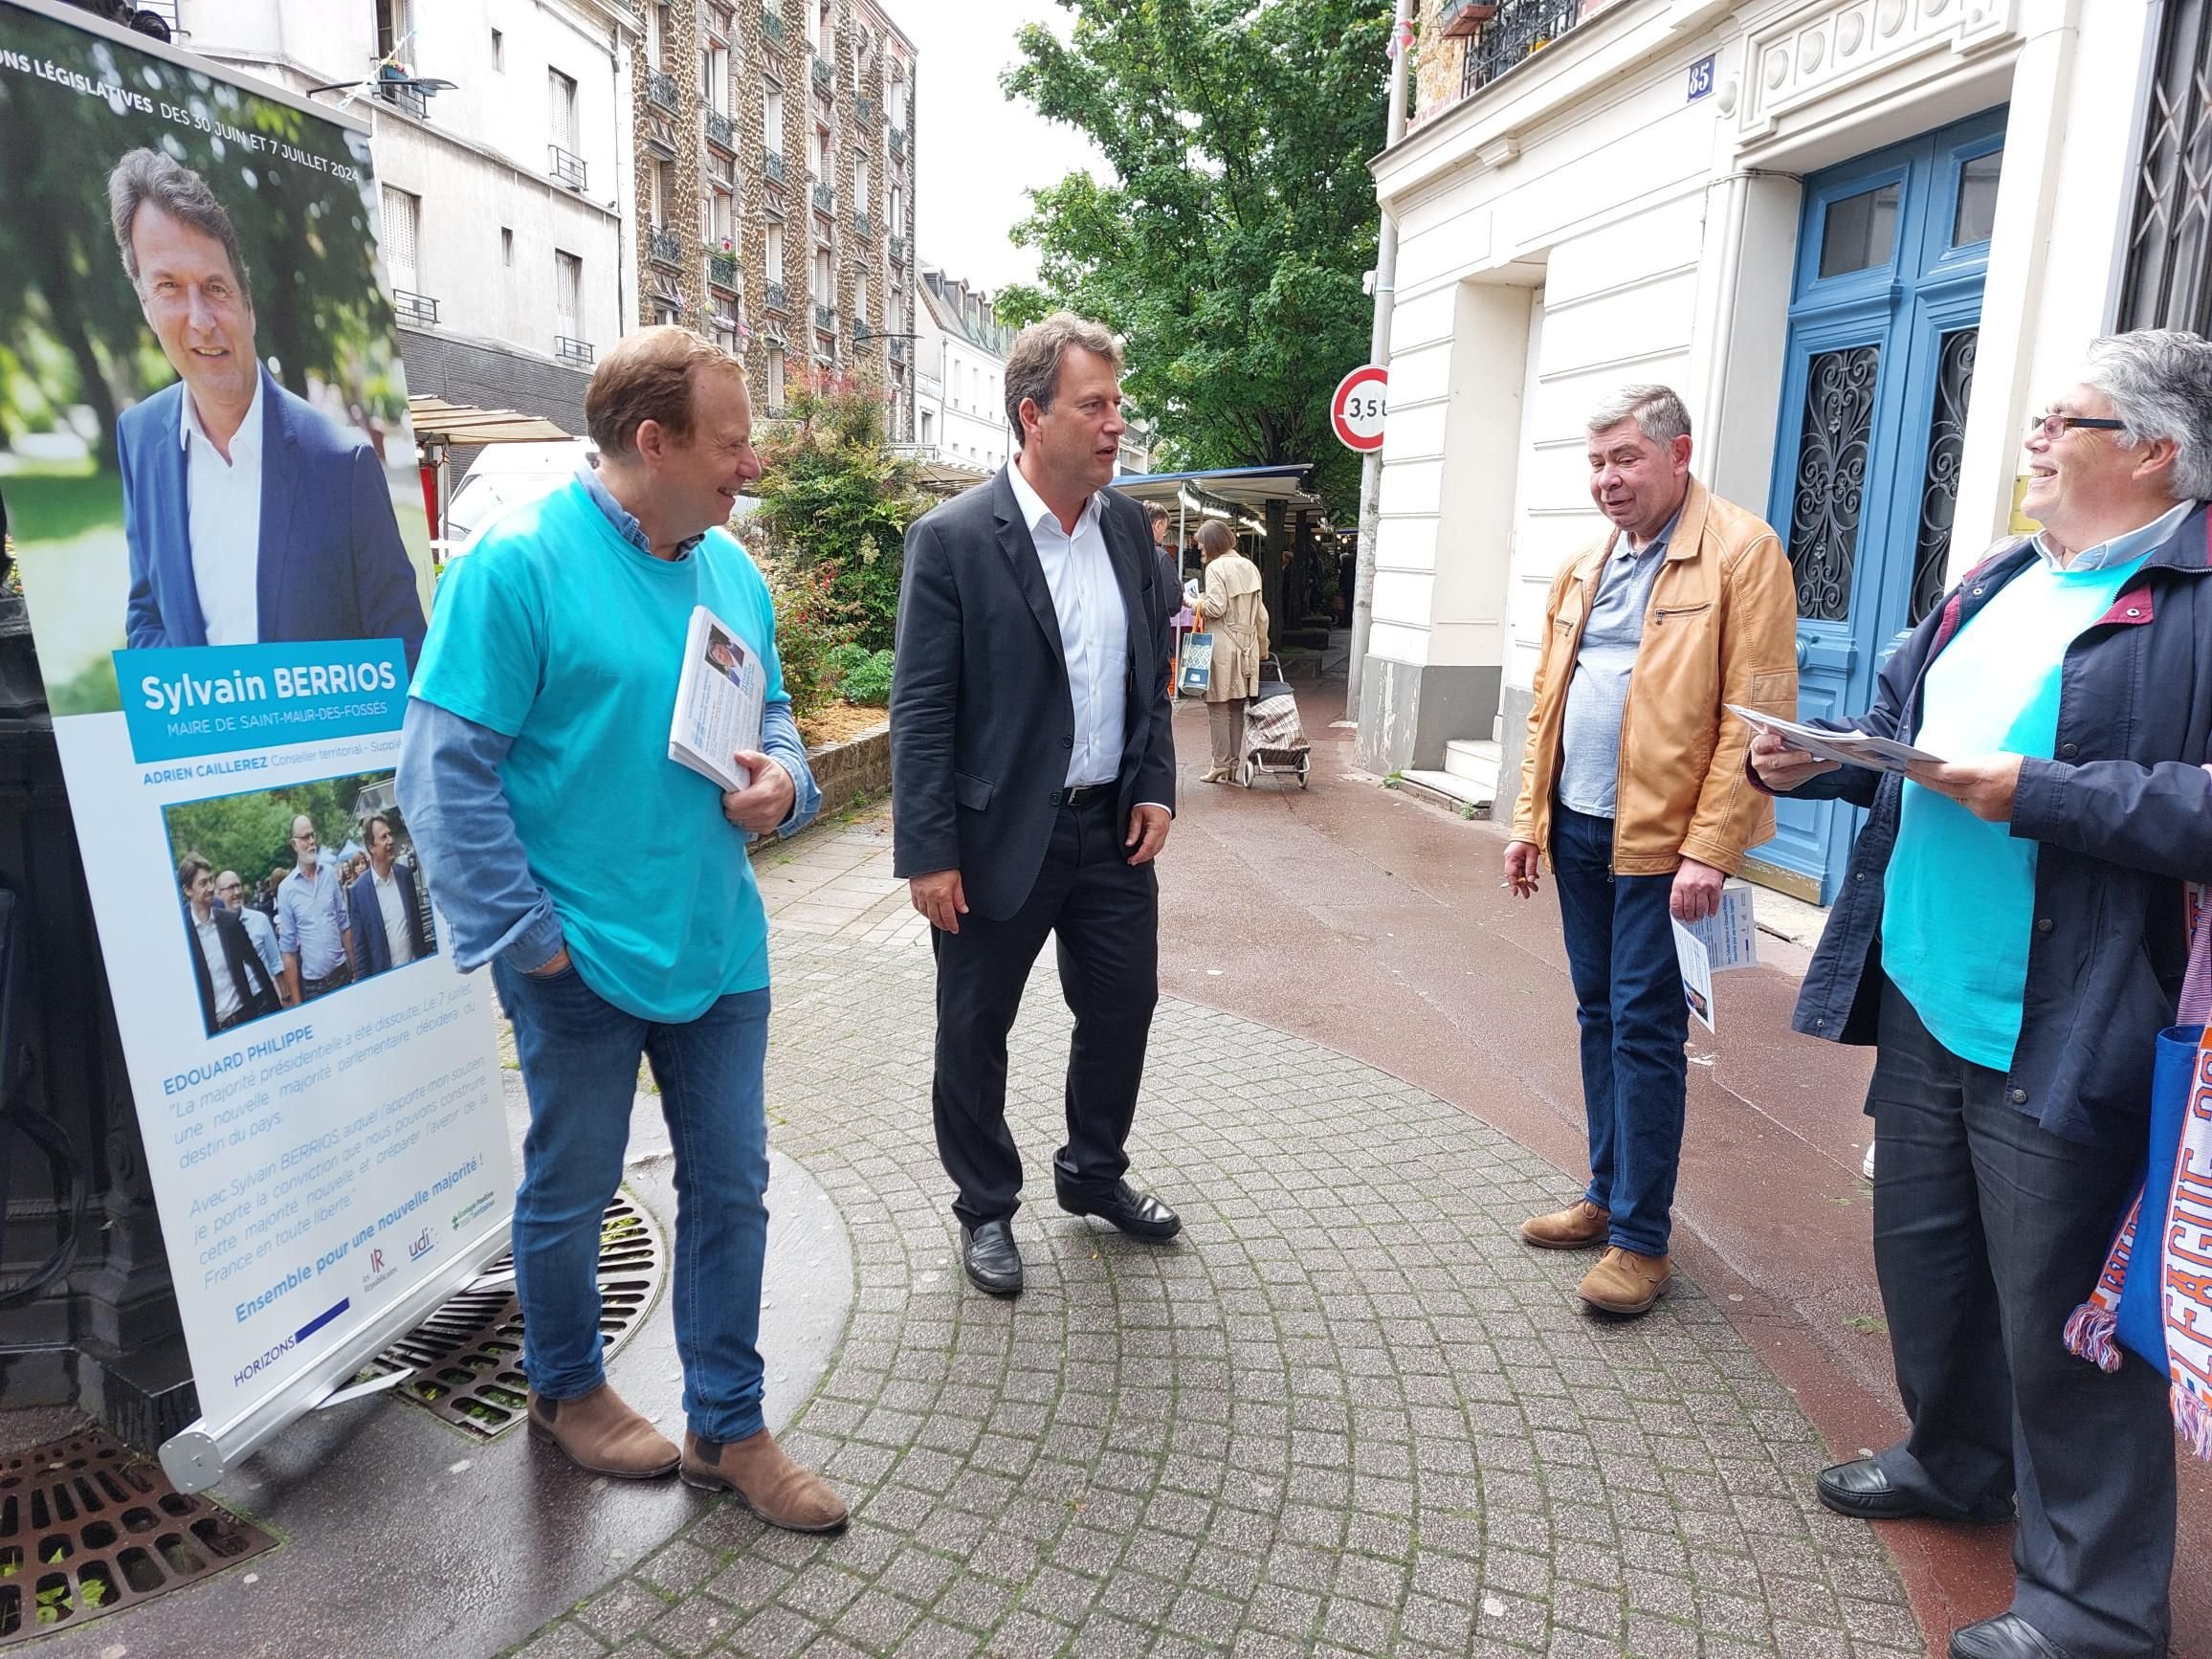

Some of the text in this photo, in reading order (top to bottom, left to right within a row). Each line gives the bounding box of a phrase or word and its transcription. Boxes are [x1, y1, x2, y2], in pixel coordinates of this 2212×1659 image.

[1690, 61, 1709, 95] 85
[33, 59, 153, 113] LÉGISLATIVES
[161, 102, 190, 125] DES
[192, 115, 211, 133] 30
[213, 122, 246, 144] JUIN
[250, 134, 267, 152] ET
[269, 141, 278, 155] 7
[281, 145, 328, 172] JUILLET
[330, 162, 359, 183] 2024
[1349, 397, 1377, 421] 3,5
[142, 661, 396, 716] Sylvain BERRIOS
[167, 701, 388, 738] MAIRE DE SAINT-MAUR-DES-FOSSÉS
[144, 768, 193, 786] ADRIEN
[195, 757, 268, 778] CAILLEREZ
[270, 750, 317, 766] Conseiller
[319, 744, 362, 759] territorial
[163, 1025, 314, 1095] EDOUARD PHILIPPE
[174, 1122, 204, 1145] une
[213, 1092, 269, 1128] nouvelle
[278, 1063, 332, 1098] majorité
[338, 1030, 409, 1073] parlementaire
[200, 1073, 257, 1108] majorité
[260, 1036, 343, 1087] présidentielle
[179, 1138, 225, 1169] destin
[229, 1129, 246, 1146] du
[189, 1188, 228, 1217] Avec
[231, 1162, 276, 1197] Sylvain
[428, 1073, 449, 1093] mon
[193, 1224, 207, 1246] je
[213, 1202, 252, 1234] porte
[256, 1192, 268, 1208] la
[273, 1155, 338, 1198] conviction
[342, 1141, 361, 1163] que
[365, 1126, 391, 1148] nous
[394, 1101, 437, 1133] pouvons
[199, 1235, 237, 1266] cette
[245, 1199, 299, 1241] majorité
[306, 1169, 354, 1206] nouvelle
[359, 1158, 370, 1174] et
[235, 1266, 312, 1323] Ensemble
[316, 1242, 349, 1276] pour
[352, 1225, 375, 1249] une
[378, 1190, 430, 1231] nouvelle
[432, 1156, 477, 1197] majorité
[409, 1227, 431, 1257] udi
[204, 1251, 253, 1290] France
[256, 1240, 272, 1259] en
[276, 1218, 311, 1247] toute
[2166, 1148, 2212, 1389] LEAGUE
[233, 1335, 295, 1387] HORIZONS
